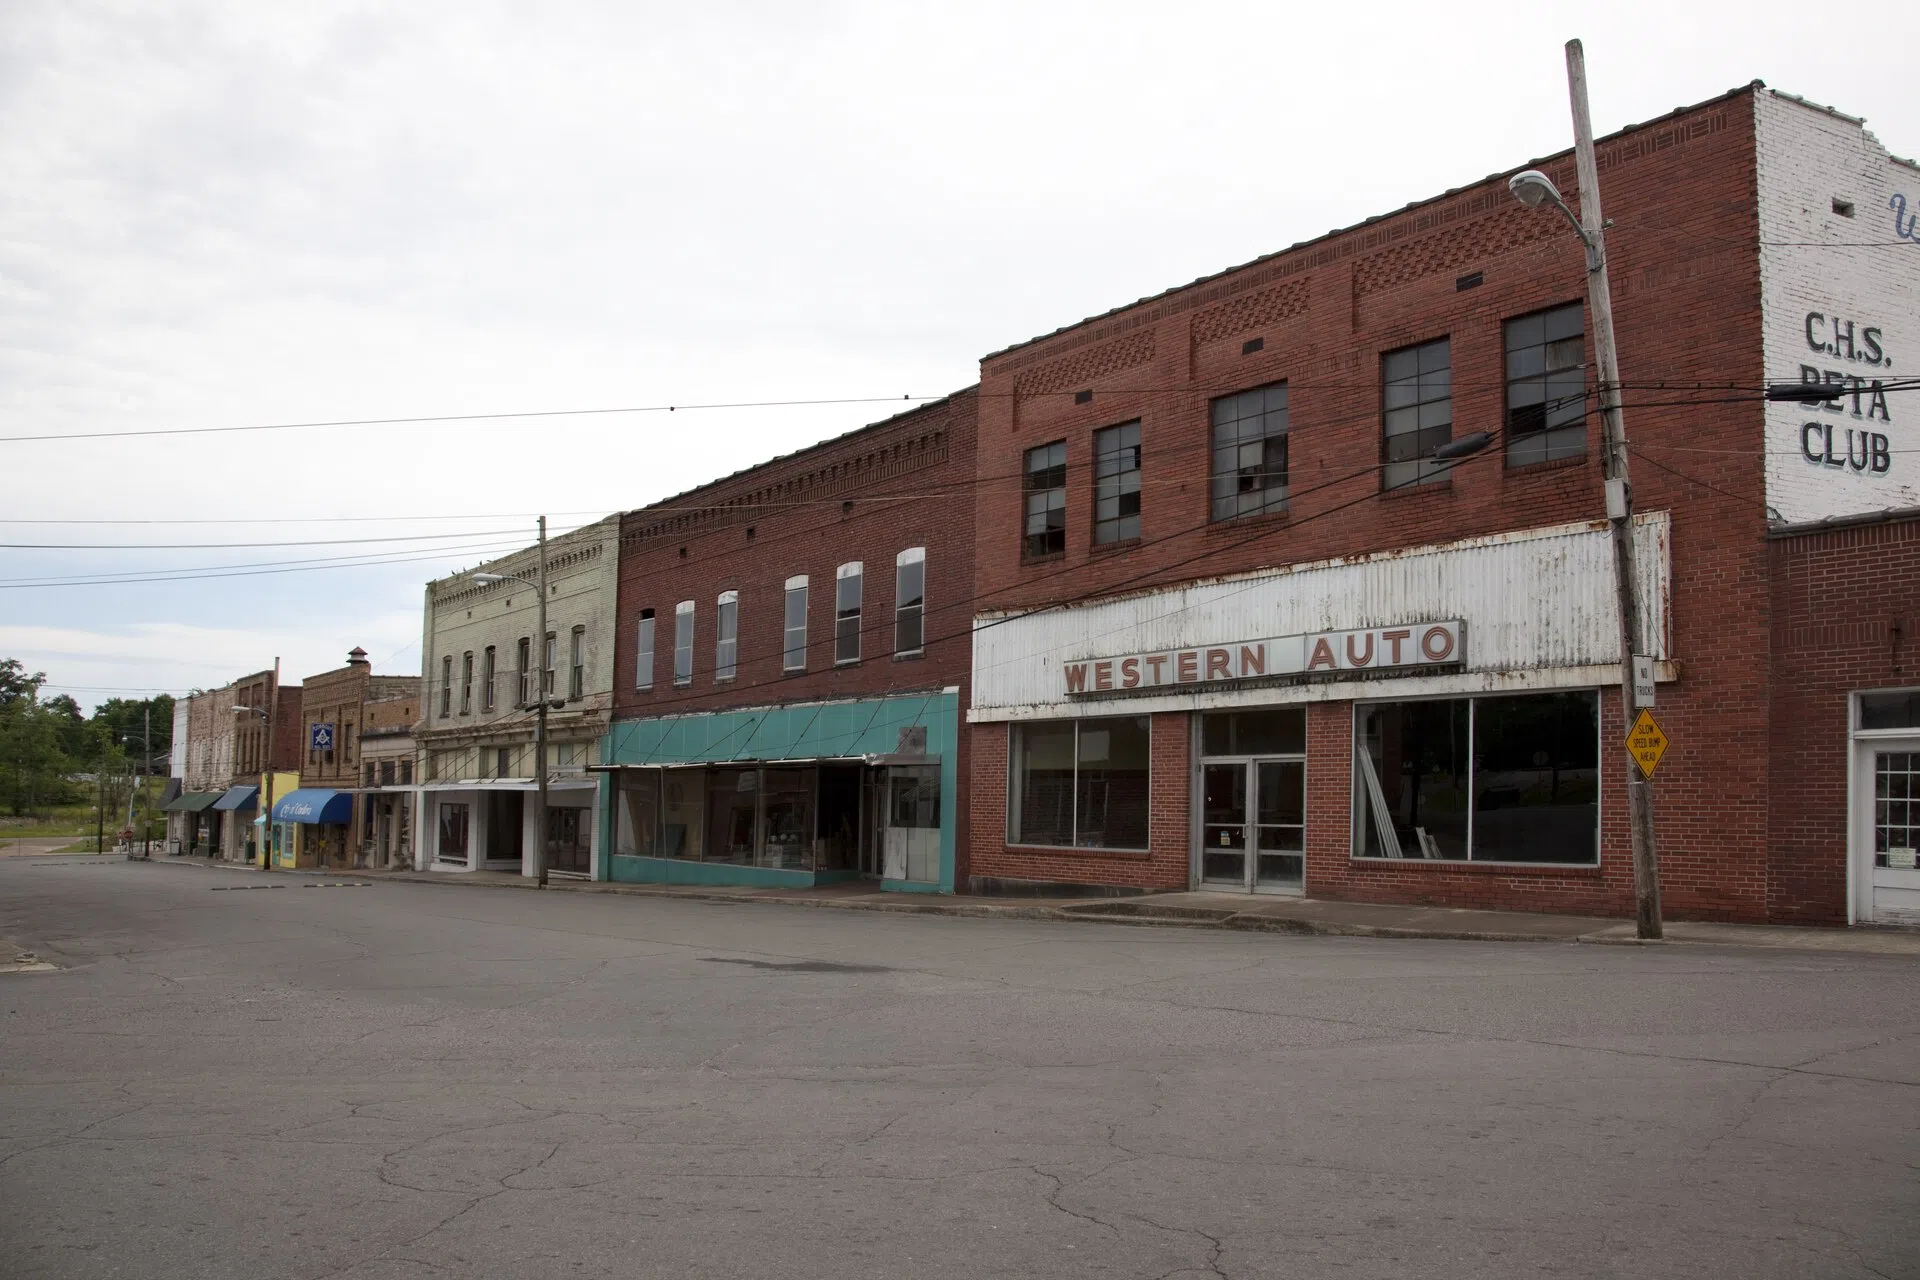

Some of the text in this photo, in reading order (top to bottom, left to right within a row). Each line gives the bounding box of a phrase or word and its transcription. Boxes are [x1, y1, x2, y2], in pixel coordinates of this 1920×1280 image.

[1805, 311, 1892, 366] C.H.S.
[1799, 363, 1891, 422] BETA
[1801, 421, 1891, 476] CLUB
[1064, 626, 1455, 692] WESTERN AUTO
[1640, 667, 1648, 679] NO
[1636, 685, 1654, 696] TRUCKS
[1638, 724, 1654, 735] SLOW
[1633, 738, 1660, 748] SPEED BUMP
[1640, 751, 1656, 761] AHEAD
